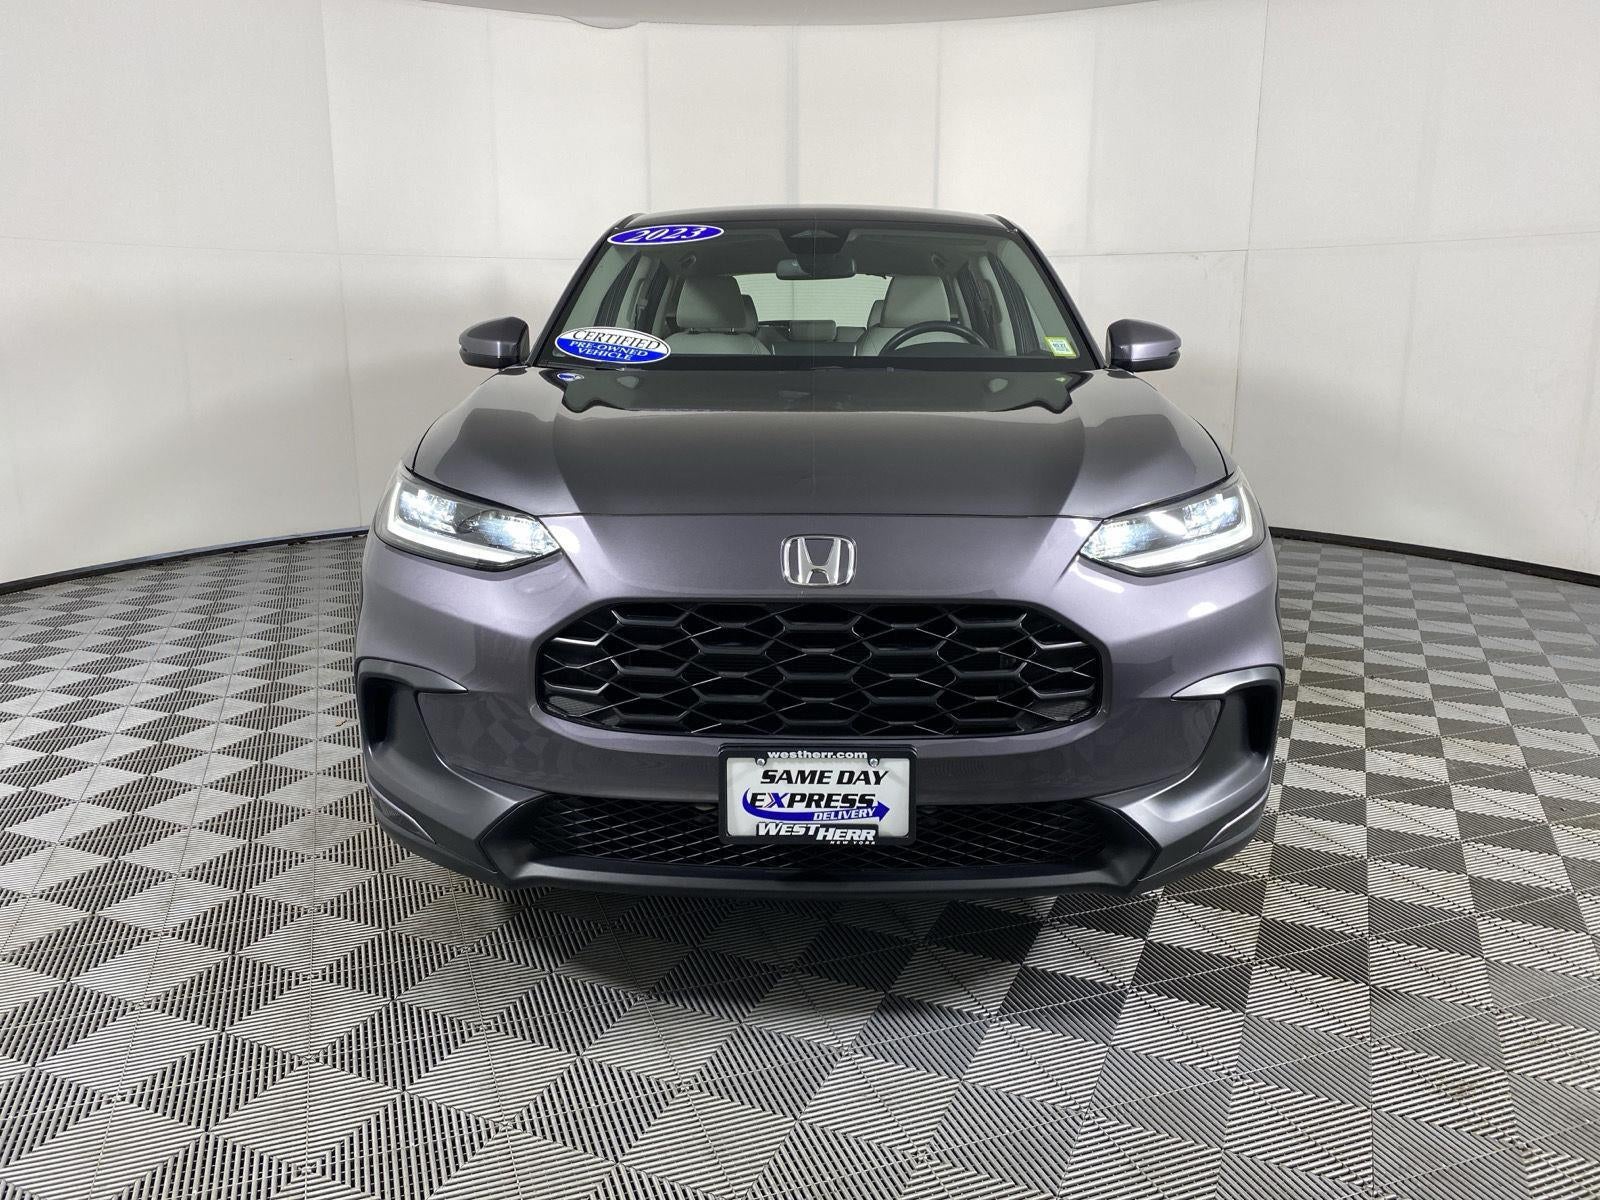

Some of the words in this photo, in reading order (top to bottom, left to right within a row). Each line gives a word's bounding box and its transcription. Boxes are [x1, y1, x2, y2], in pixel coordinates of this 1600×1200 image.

[623, 227, 707, 242] 2023
[573, 330, 661, 350] CERTIFIED
[569, 341, 648, 356] PRE-OWNED
[578, 347, 633, 360] VEHICLE
[767, 750, 868, 759] westherr.com
[760, 769, 833, 785] SAME
[836, 769, 890, 786] DAY
[749, 792, 876, 809] EXPRESS
[813, 807, 876, 821] DELIVERY
